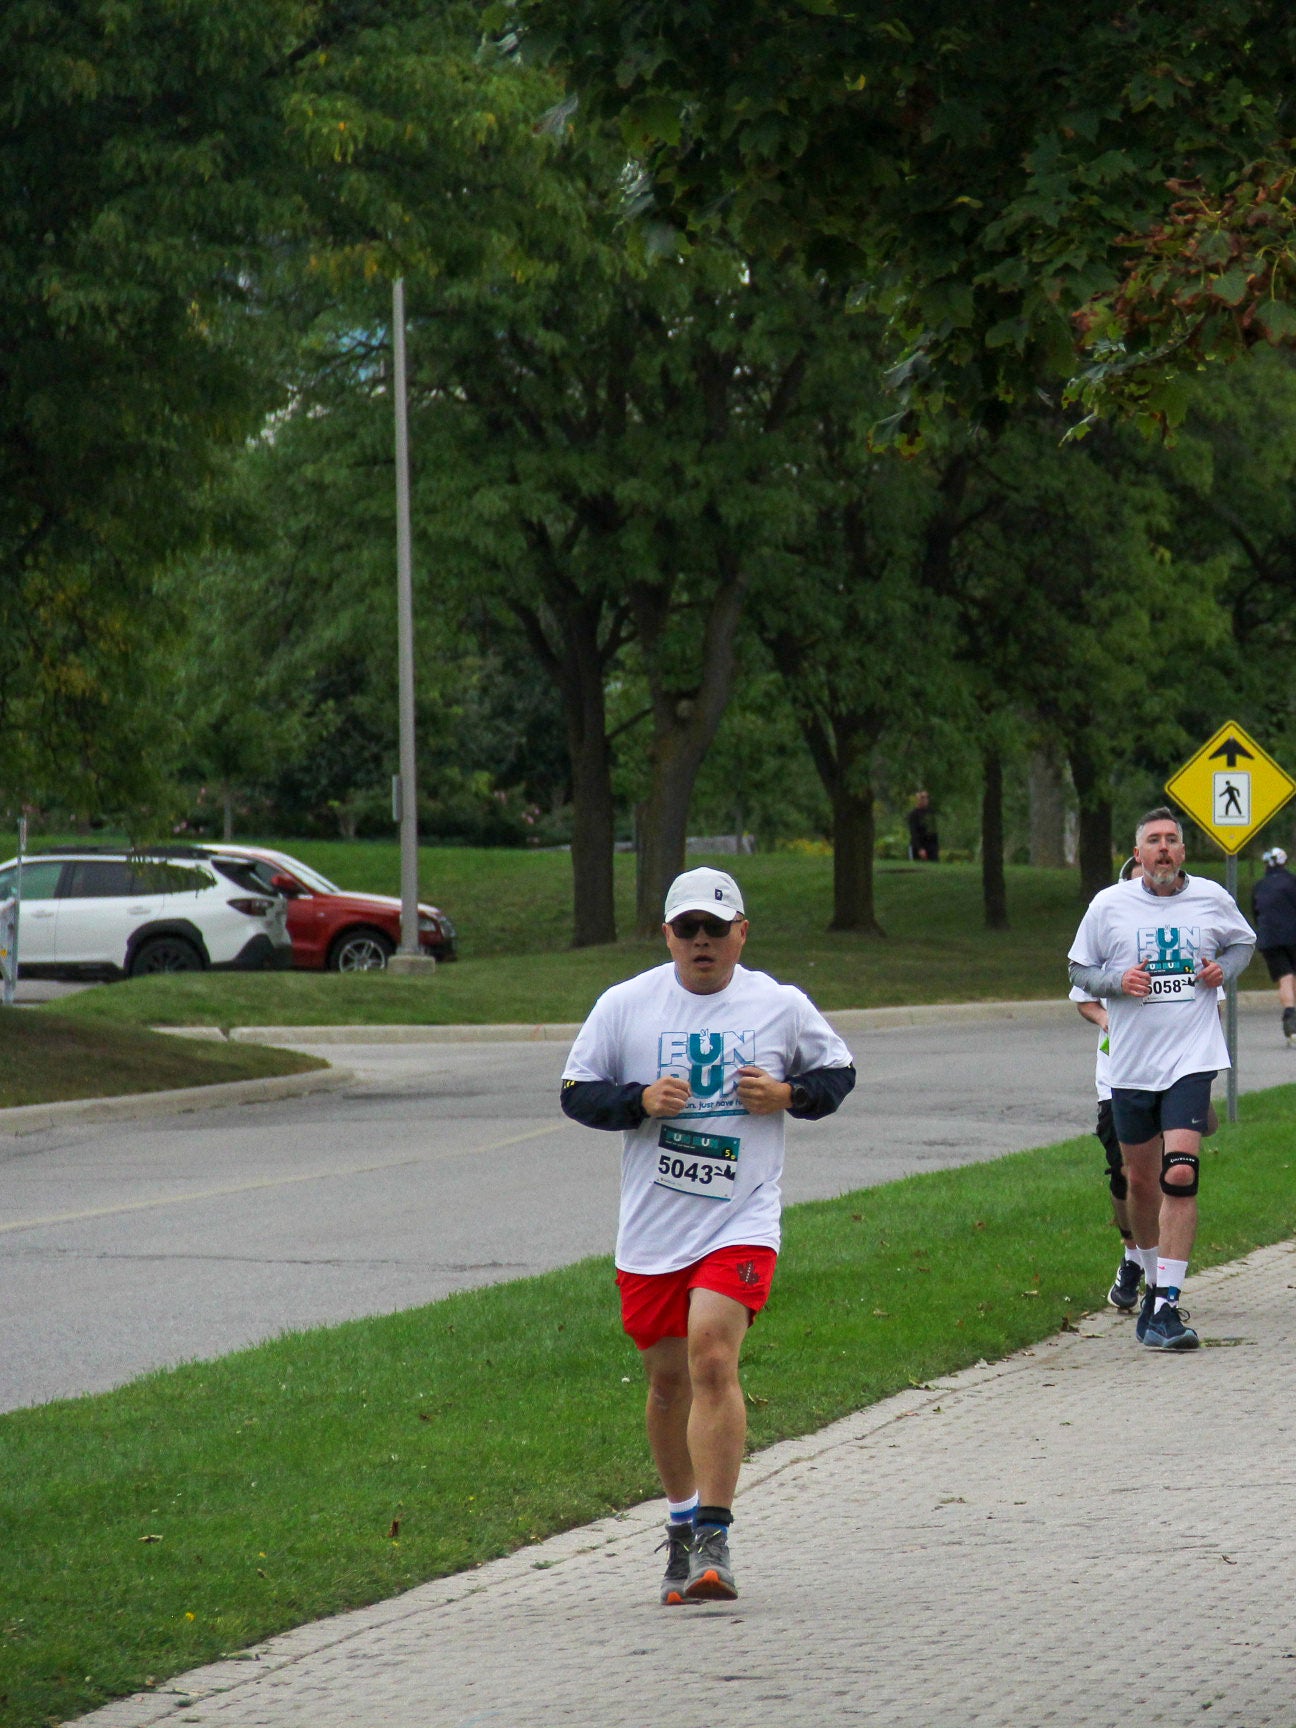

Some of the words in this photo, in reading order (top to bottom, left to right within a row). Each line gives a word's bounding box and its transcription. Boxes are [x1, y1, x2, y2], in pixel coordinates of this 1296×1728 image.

[1137, 926, 1200, 950] FUN
[657, 1029, 756, 1068] FUN
[699, 1101, 714, 1110] just
[716, 1099, 734, 1107] have
[658, 1155, 714, 1185] 5043
